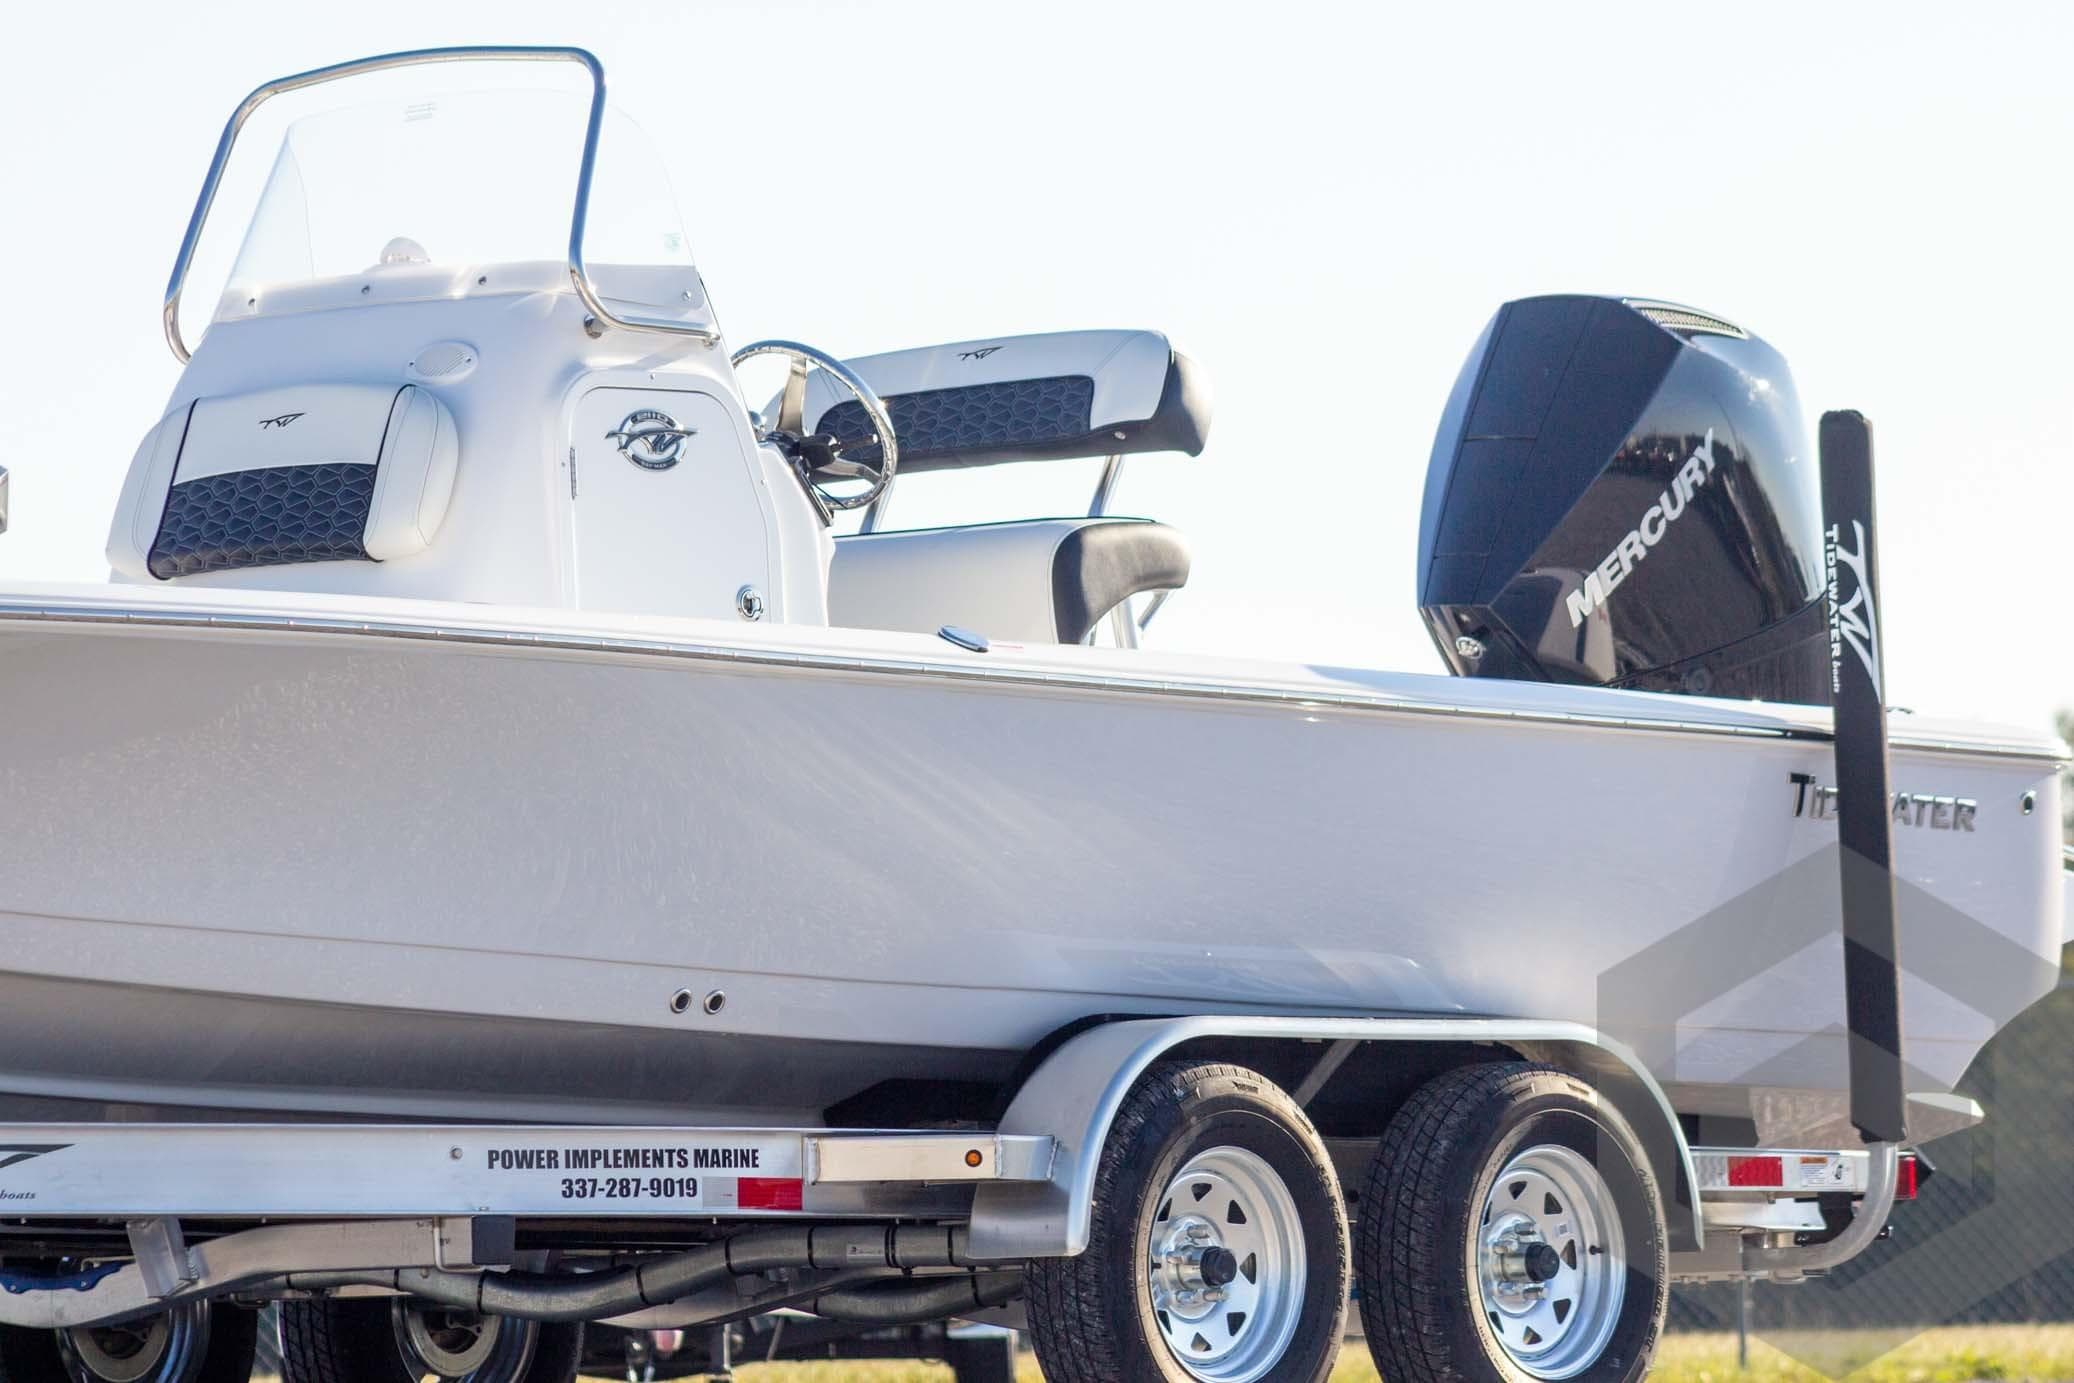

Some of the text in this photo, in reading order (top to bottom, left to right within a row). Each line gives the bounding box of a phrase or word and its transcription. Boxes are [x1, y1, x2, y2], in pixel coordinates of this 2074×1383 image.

[1566, 427, 1715, 628] MERCURY
[1825, 523, 1842, 659] TIDEWATER
[1787, 772, 1977, 832] TIDATER
[487, 1148, 760, 1169] POWER IMPLEMENTS MARINE
[0, 1189, 36, 1200] boats
[561, 1177, 698, 1198] 337-287-9019
